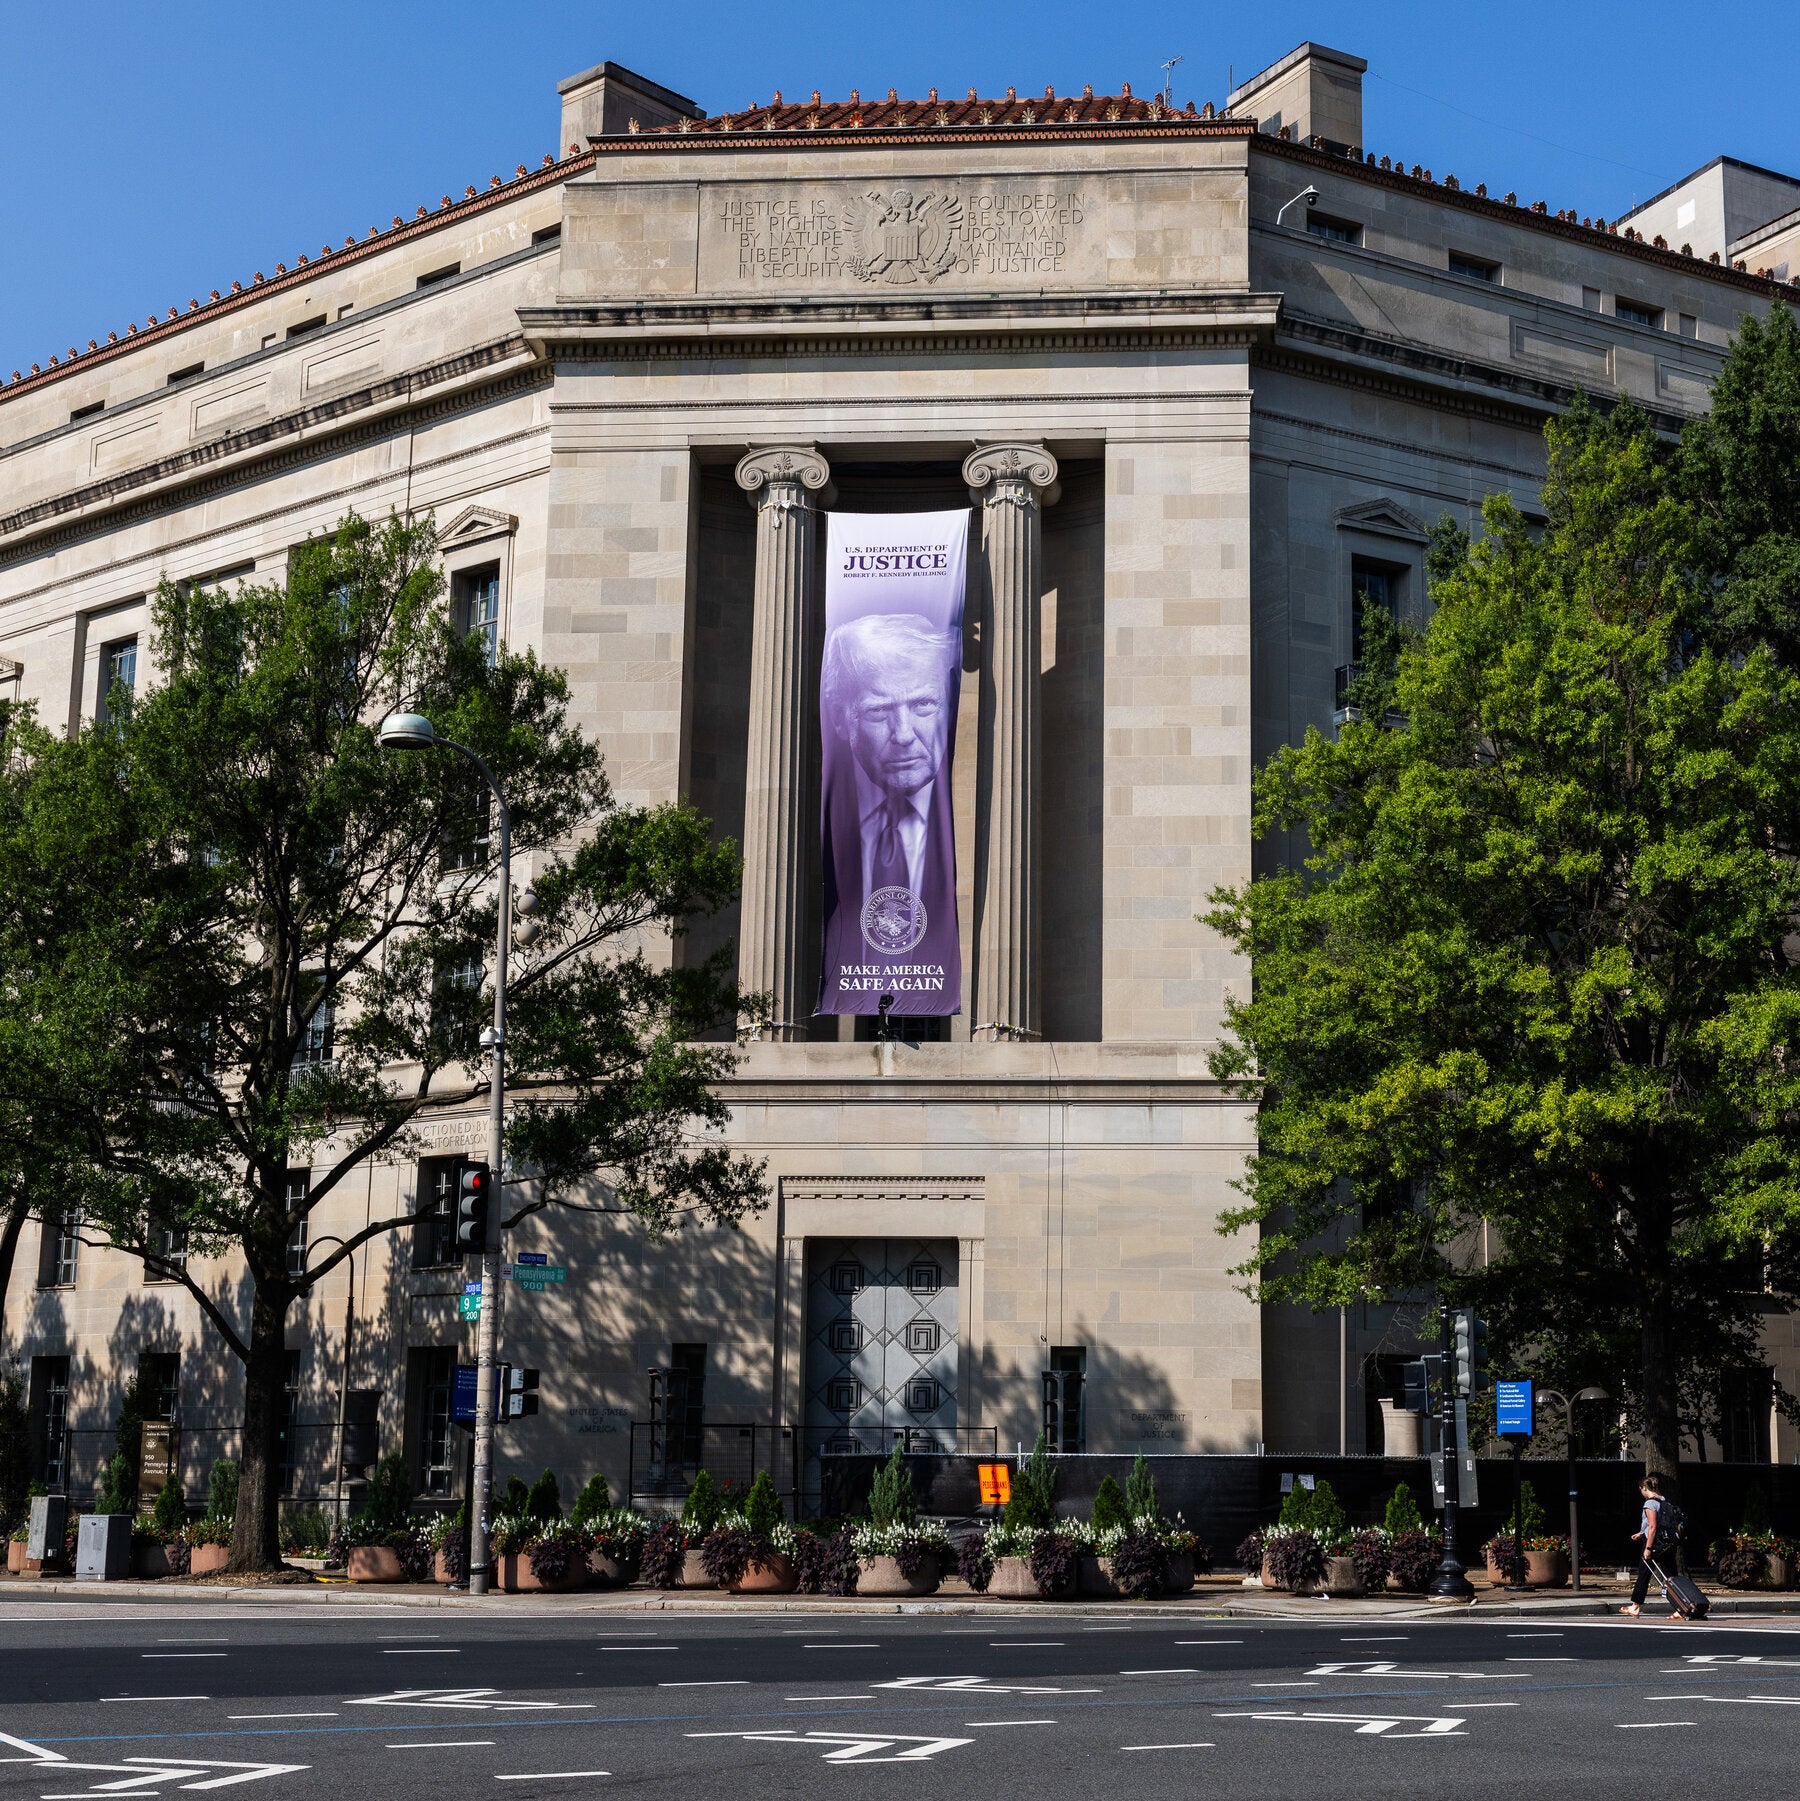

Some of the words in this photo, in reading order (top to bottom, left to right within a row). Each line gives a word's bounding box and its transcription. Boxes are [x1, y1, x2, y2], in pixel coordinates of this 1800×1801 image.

[719, 200, 799, 217] JUSTICE
[811, 200, 826, 214] IS
[969, 194, 1058, 210] FOUNDED
[1067, 193, 1085, 209] IN
[721, 217, 755, 232] THE
[769, 215, 837, 231] RIGHTS
[968, 209, 1084, 226] BESTOWED
[740, 232, 760, 247] BY
[770, 231, 844, 246] NATURE
[958, 226, 1011, 242] UPON
[739, 247, 814, 263] LIBERTY
[825, 246, 840, 261] IS
[958, 241, 1066, 257] MAINTAINED
[739, 263, 755, 278] IN
[762, 261, 846, 277] SECURITY
[955, 258, 980, 274] OF
[987, 257, 1066, 274] JUSTICE.
[865, 545, 933, 553] DEPARTMENT
[843, 553, 947, 570] JUSTICE
[840, 965, 880, 975] MAKE
[882, 964, 944, 975] AMERICA
[839, 978, 884, 991] SAFE
[887, 977, 944, 991] AGAIN
[514, 1266, 555, 1281] Pennsylvania
[522, 1281, 543, 1290] 900
[464, 1297, 470, 1310] 9
[466, 1311, 478, 1319] 200
[570, 1408, 598, 1416] UNITED
[602, 1408, 628, 1416] STATES
[1131, 1413, 1186, 1422] DEPARTMENT
[592, 1416, 604, 1424] OF
[1153, 1422, 1164, 1430] OF
[1141, 1430, 1176, 1438] JUSTICE
